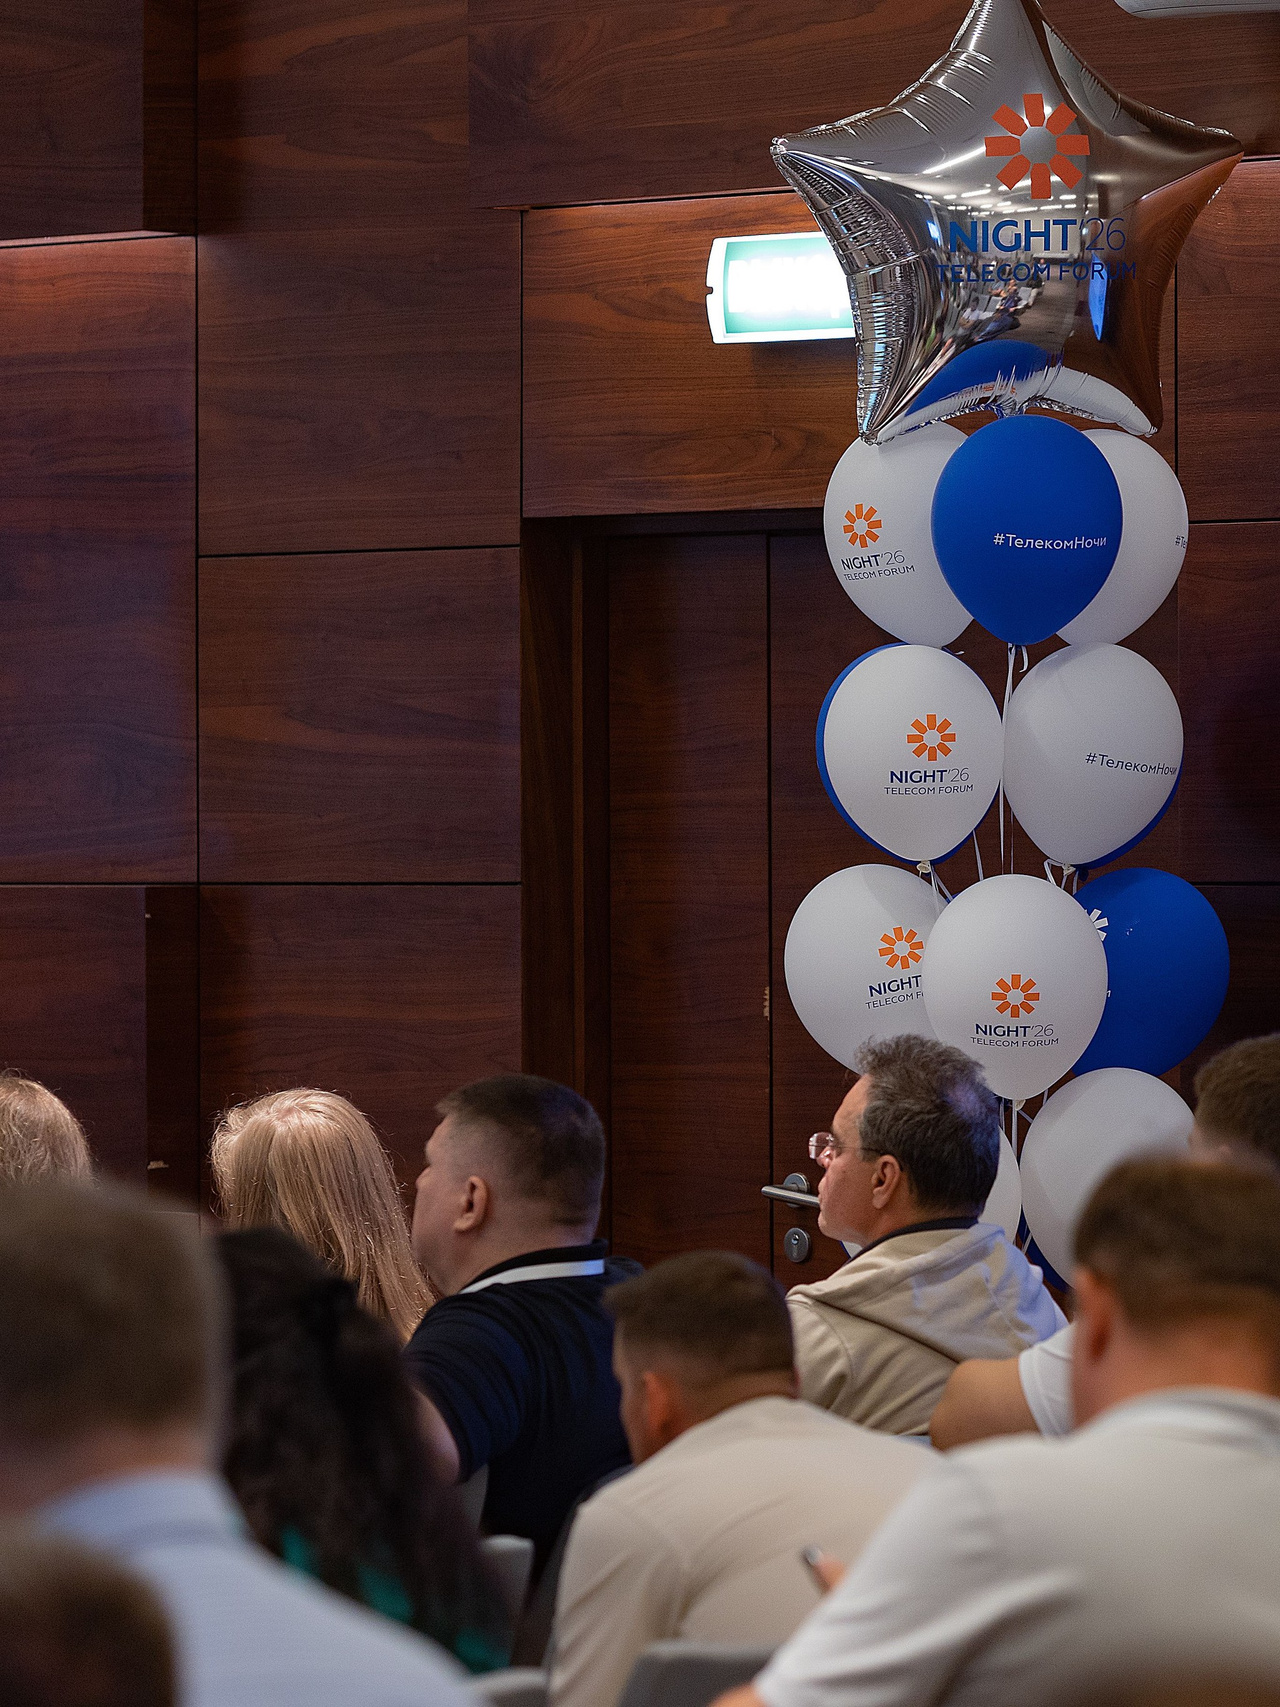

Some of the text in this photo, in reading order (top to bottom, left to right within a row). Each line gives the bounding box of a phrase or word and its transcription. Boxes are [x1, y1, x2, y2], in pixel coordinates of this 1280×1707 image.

[936, 262, 1136, 283] TELECOM FORUM
[993, 533, 1107, 549] #ТелекомНочи
[844, 565, 915, 581] TELECOM FORUM
[1085, 752, 1177, 775] #ТелекомНочи
[884, 784, 974, 795] TELECOM FORUM
[865, 993, 914, 1009] TELECOM
[970, 1037, 1059, 1047] TELECOM FORUM
